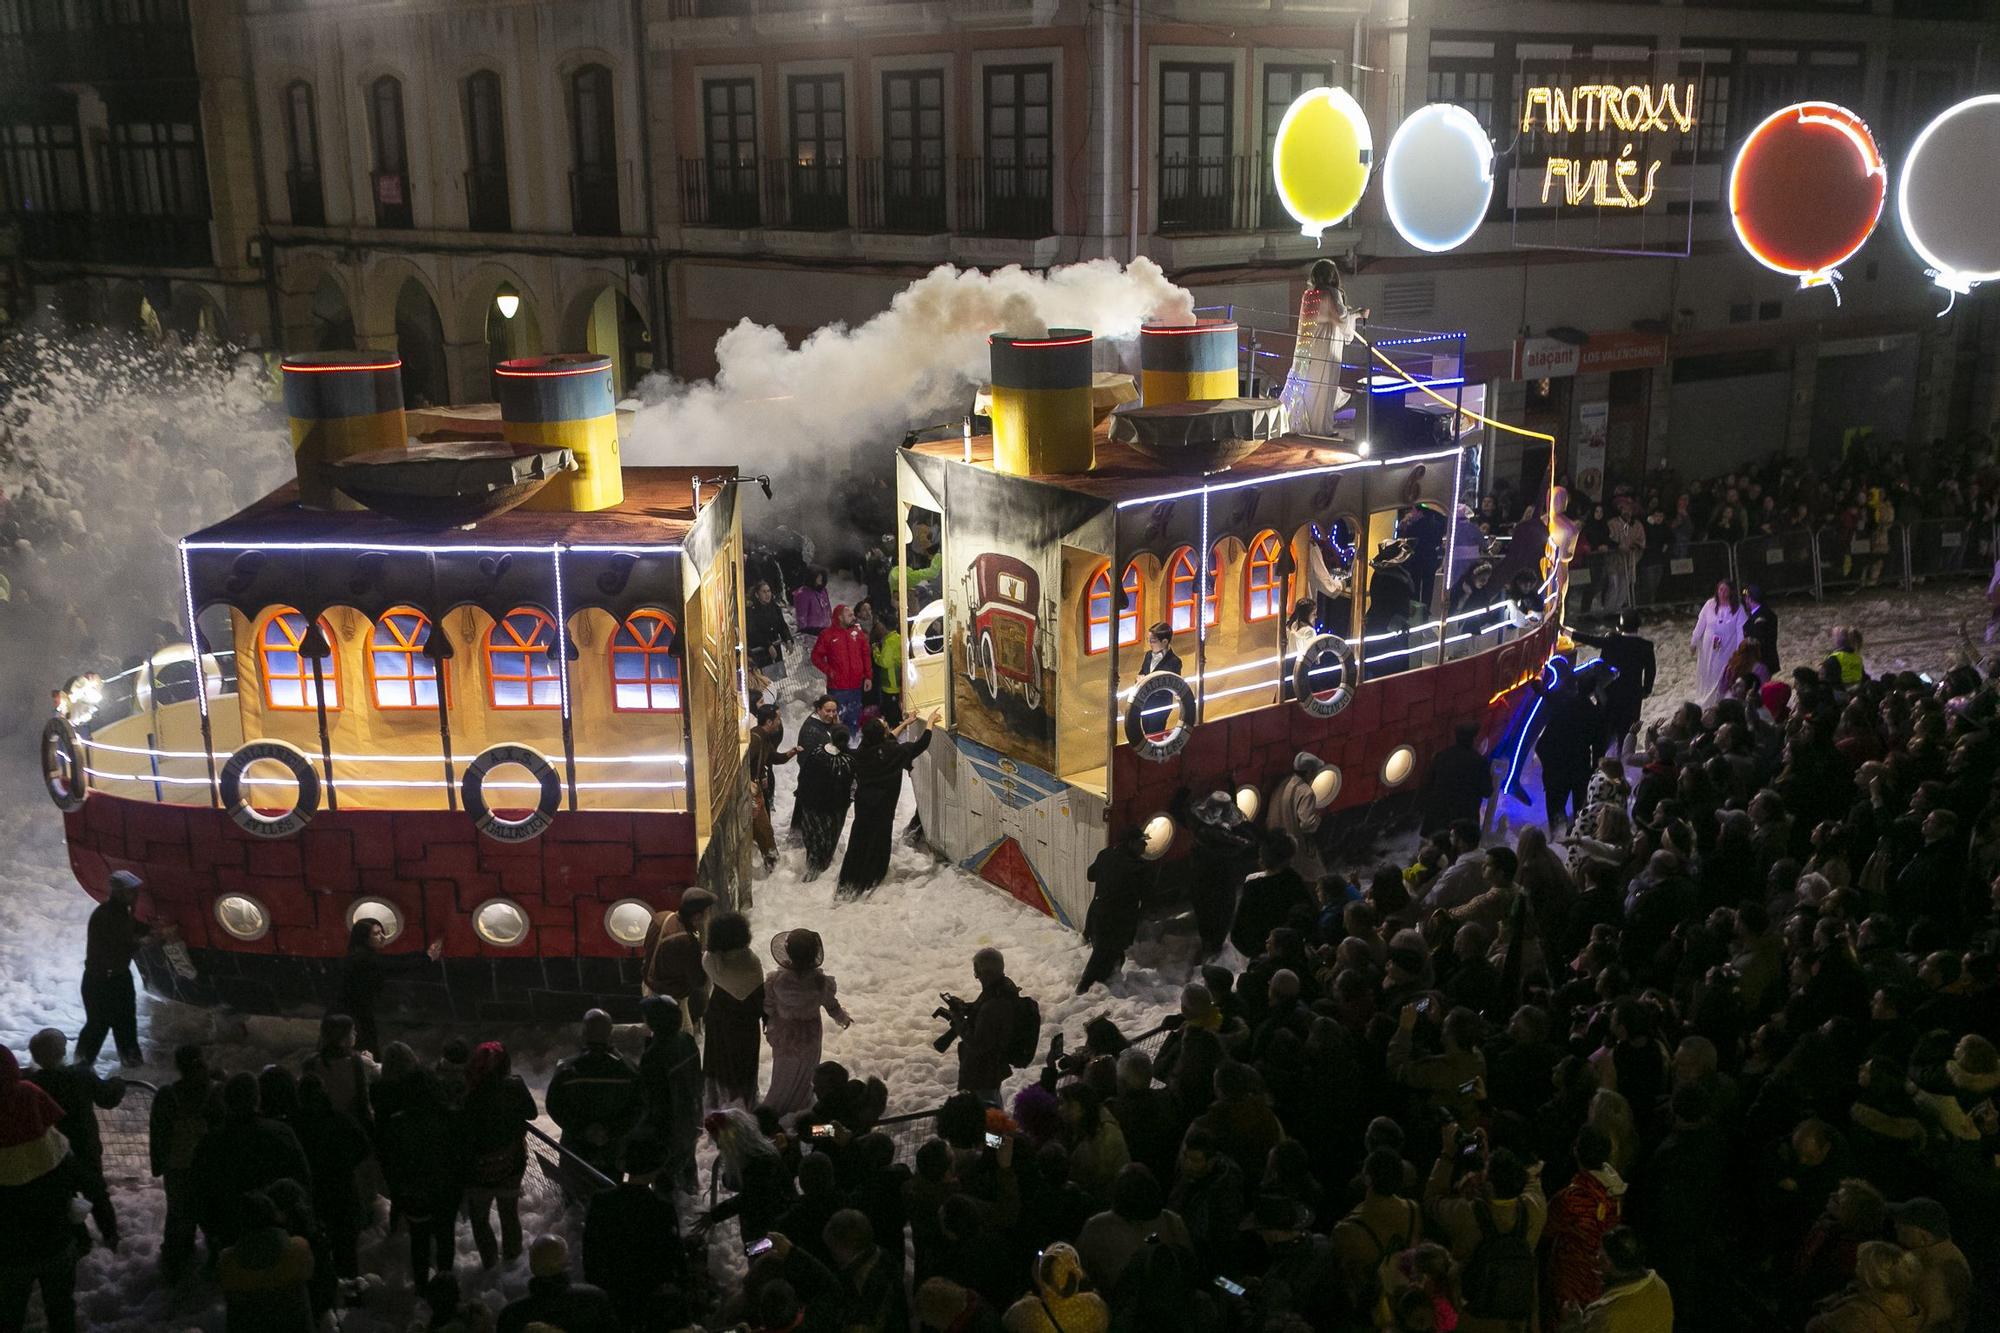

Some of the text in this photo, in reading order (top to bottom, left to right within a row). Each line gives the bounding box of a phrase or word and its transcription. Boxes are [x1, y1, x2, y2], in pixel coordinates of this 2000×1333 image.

[1522, 83, 1695, 133] ANTROXU
[1541, 143, 1662, 208] AVILÉS
[1583, 351, 1600, 364] LOS
